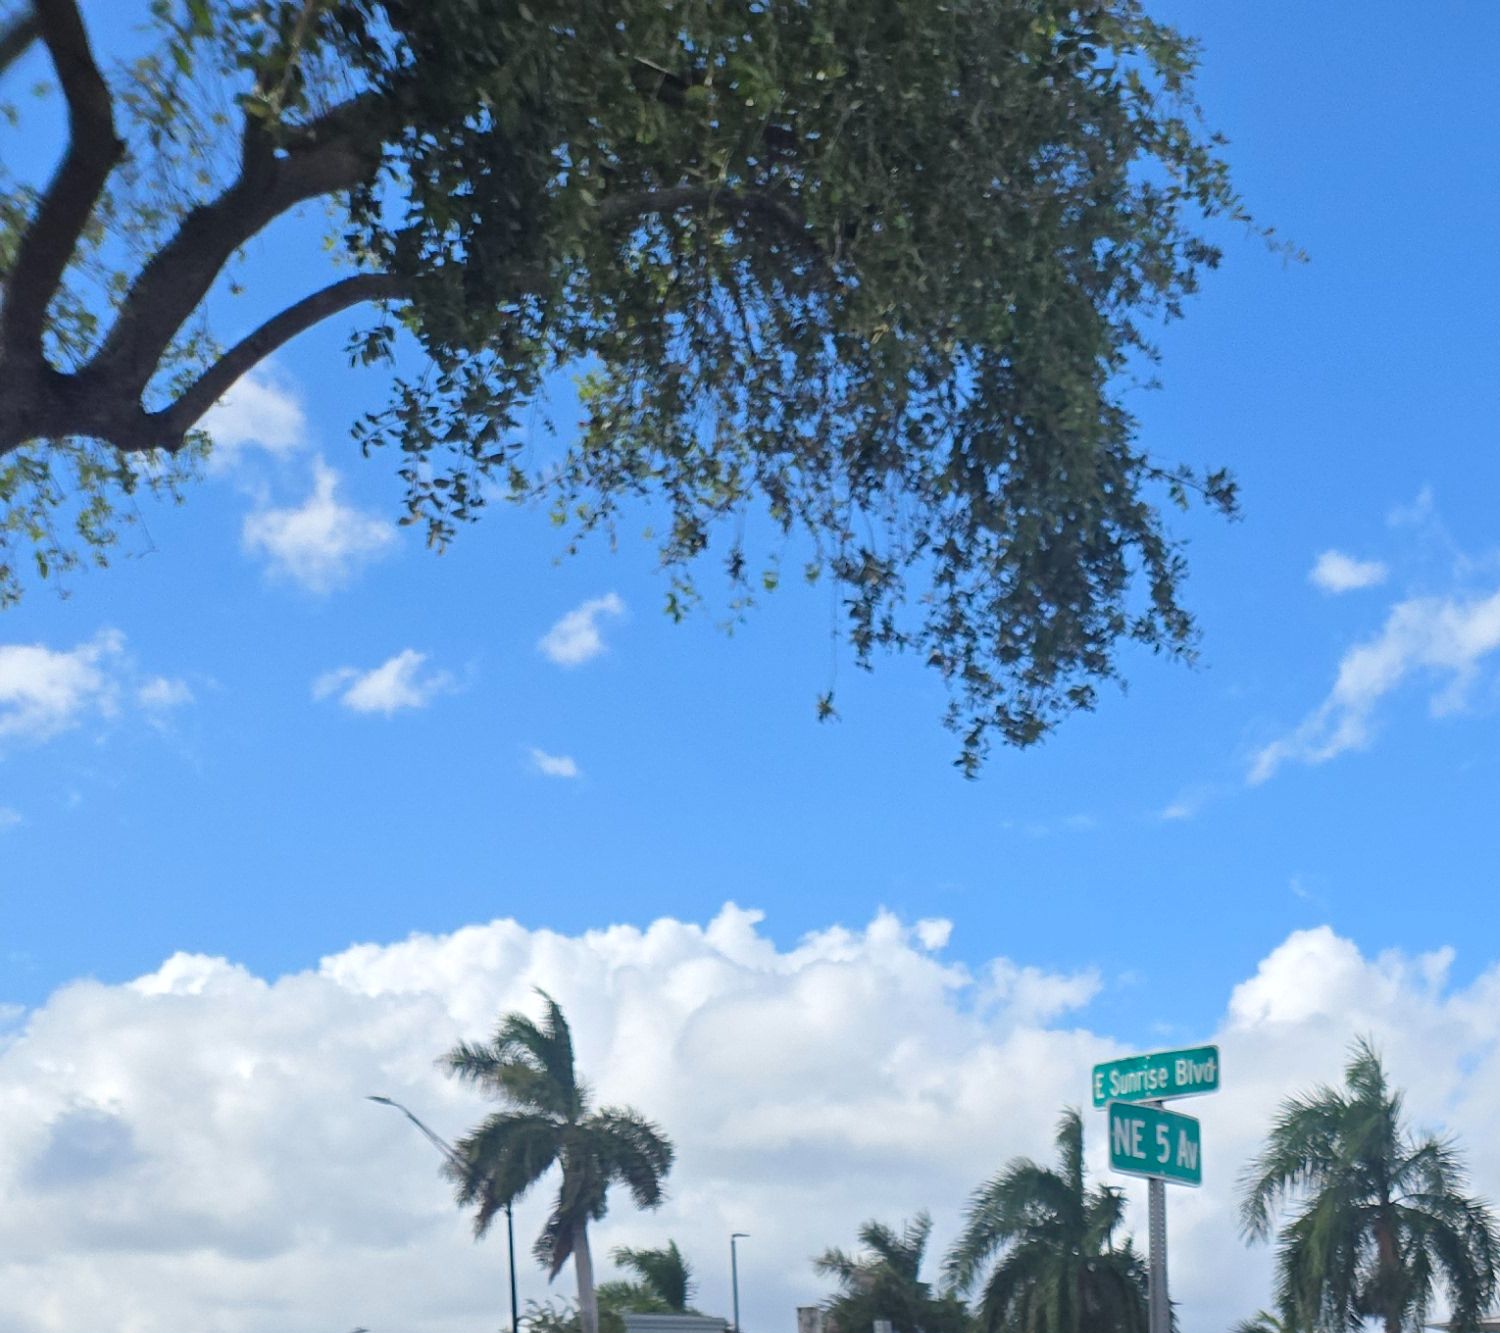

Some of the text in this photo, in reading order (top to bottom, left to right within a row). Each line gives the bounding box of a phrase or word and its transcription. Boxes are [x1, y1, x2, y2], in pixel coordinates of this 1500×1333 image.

[1095, 1058, 1216, 1098] E Sunrise Blvd
[1112, 1116, 1146, 1159] NE
[1157, 1125, 1171, 1163] 5
